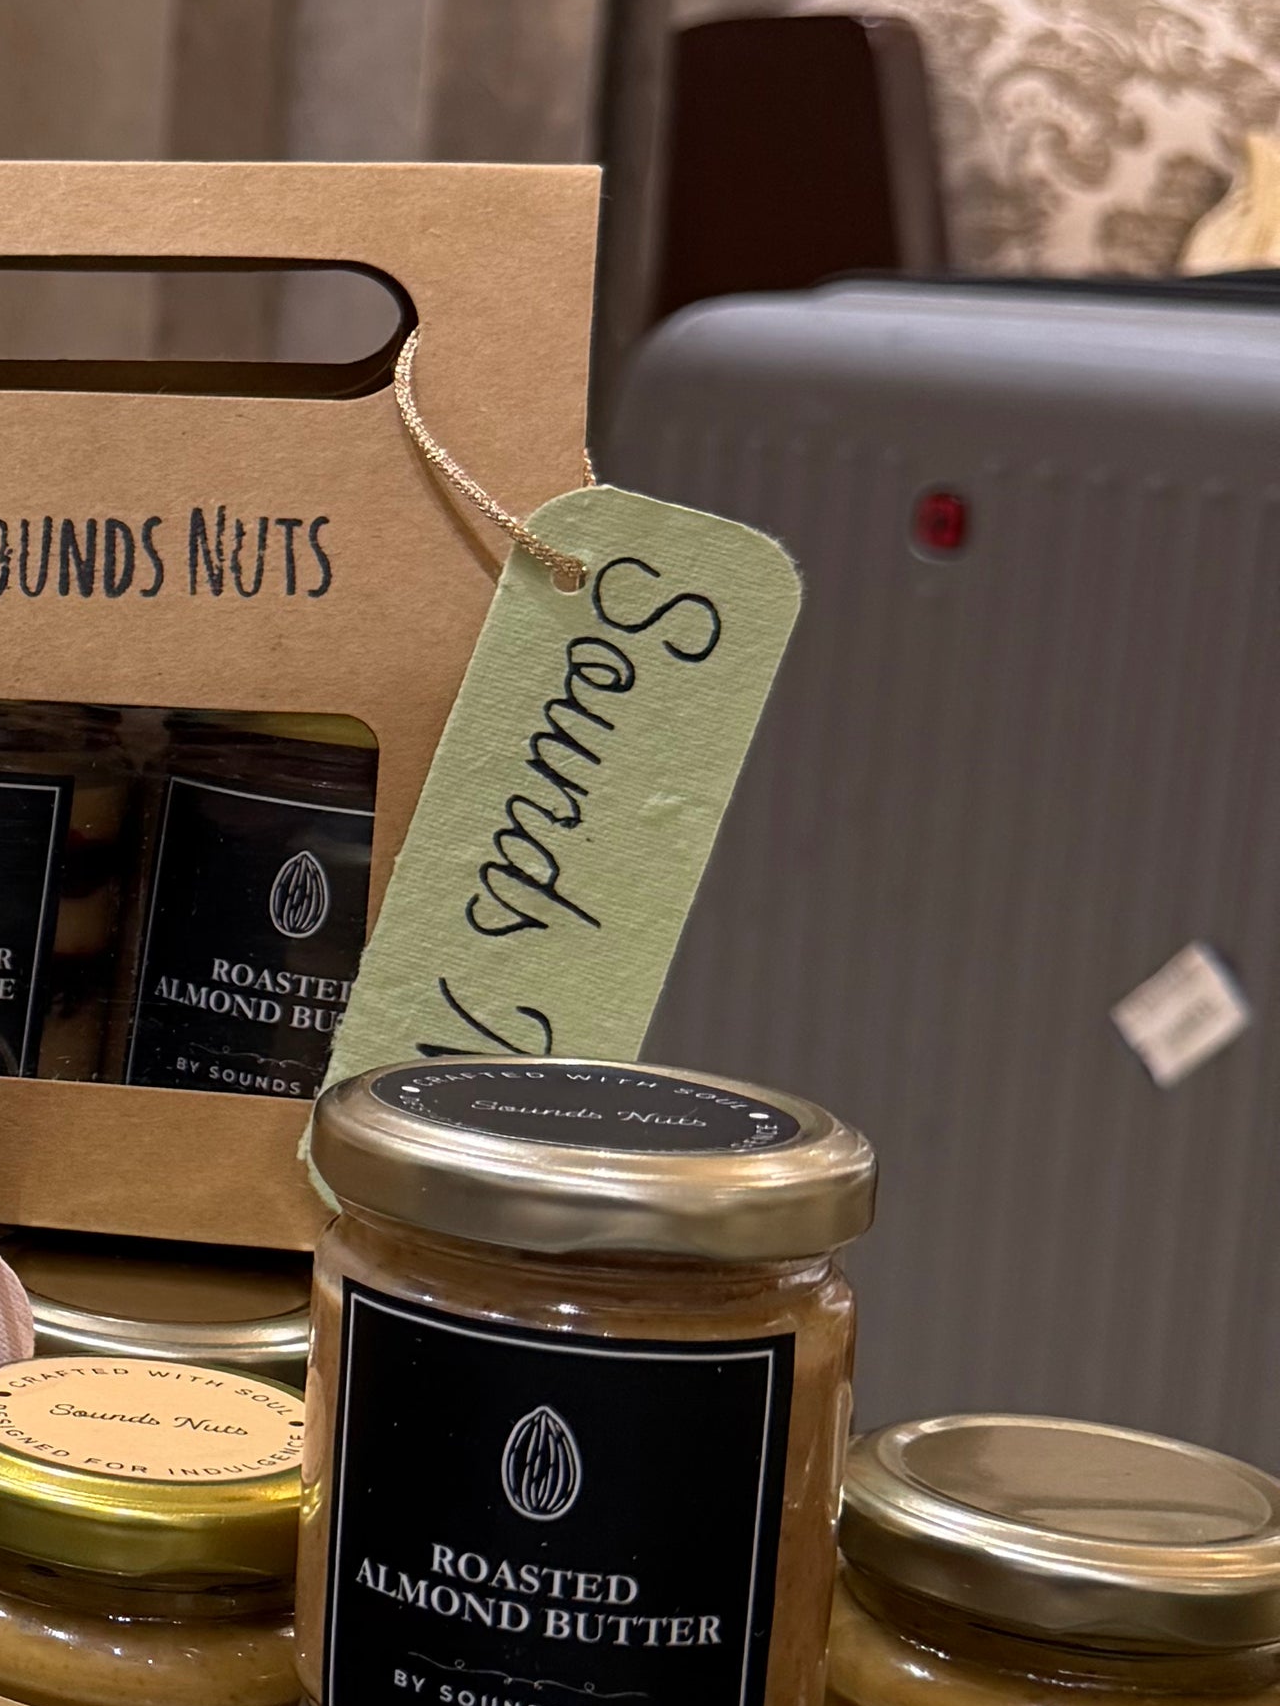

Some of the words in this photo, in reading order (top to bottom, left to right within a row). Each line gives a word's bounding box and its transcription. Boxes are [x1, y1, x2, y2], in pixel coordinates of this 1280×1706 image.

[188, 504, 332, 598] NUTS
[465, 557, 721, 937] Sounds
[154, 975, 282, 1025] ALMOND
[176, 1056, 200, 1074] BY
[209, 1065, 301, 1094] SOUNDS
[413, 1072, 545, 1086] CRAFTED
[566, 1073, 657, 1088] WITH
[674, 1088, 748, 1109] SOUL
[471, 1100, 602, 1119] Sounds
[617, 1108, 707, 1127] Nuts
[8, 1367, 129, 1388] CRAFTED
[147, 1369, 224, 1388] WITH
[235, 1388, 293, 1416] SOUL
[49, 1403, 161, 1426] Sounds
[173, 1415, 249, 1436] Nuts
[84, 1457, 148, 1474] FOR
[168, 1433, 304, 1477] INDULGENCE
[430, 1542, 639, 1605] ROASTED
[355, 1556, 531, 1633] ALMOND
[542, 1608, 723, 1647] BUTTER
[393, 1668, 426, 1693] BY
